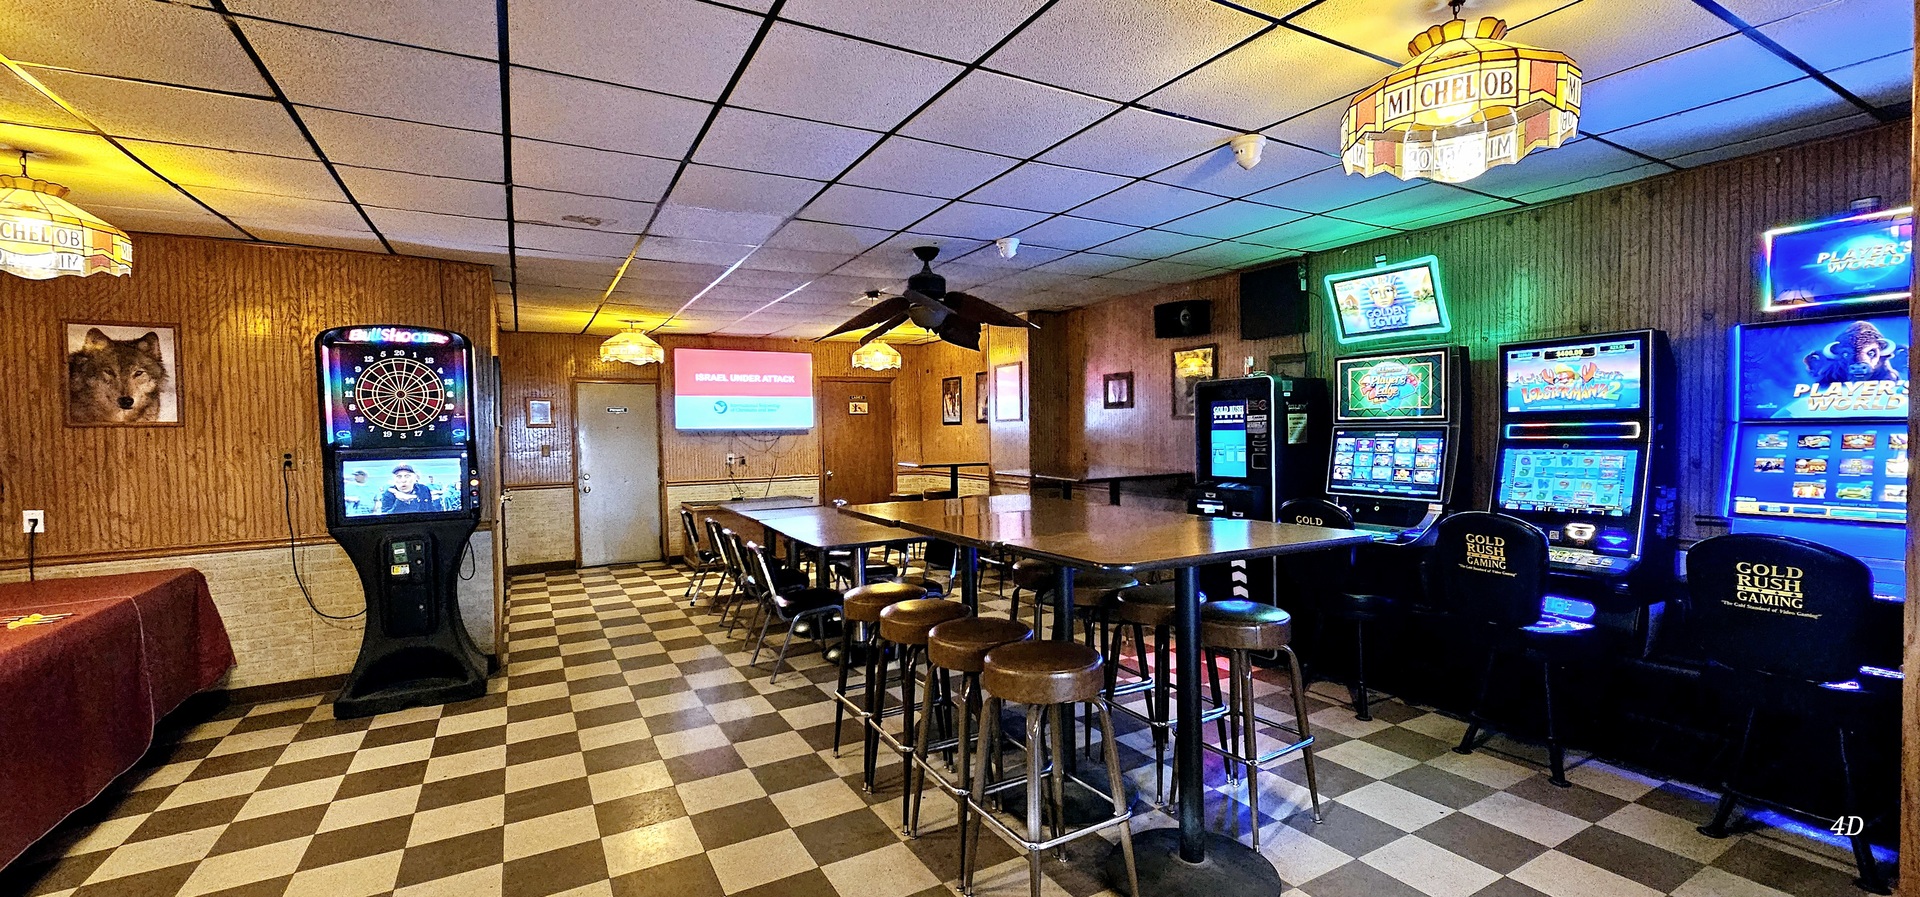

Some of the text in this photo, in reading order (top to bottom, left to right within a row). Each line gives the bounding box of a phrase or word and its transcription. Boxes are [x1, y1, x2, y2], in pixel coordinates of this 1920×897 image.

[1827, 253, 1905, 274] WORLD
[1366, 305, 1407, 318] GOLDEN
[1369, 315, 1408, 328] EGYPT
[695, 373, 795, 383] ISRAEL UNDER ATTACK
[1808, 396, 1905, 411] WORLD
[1296, 515, 1323, 525] GOLD
[1465, 533, 1505, 547] GOLD
[1466, 542, 1504, 556] RUSH
[1467, 556, 1506, 570] GAMING
[1736, 562, 1803, 579] GOLD
[1737, 573, 1801, 592] RUSH
[1737, 591, 1803, 609] GAMING
